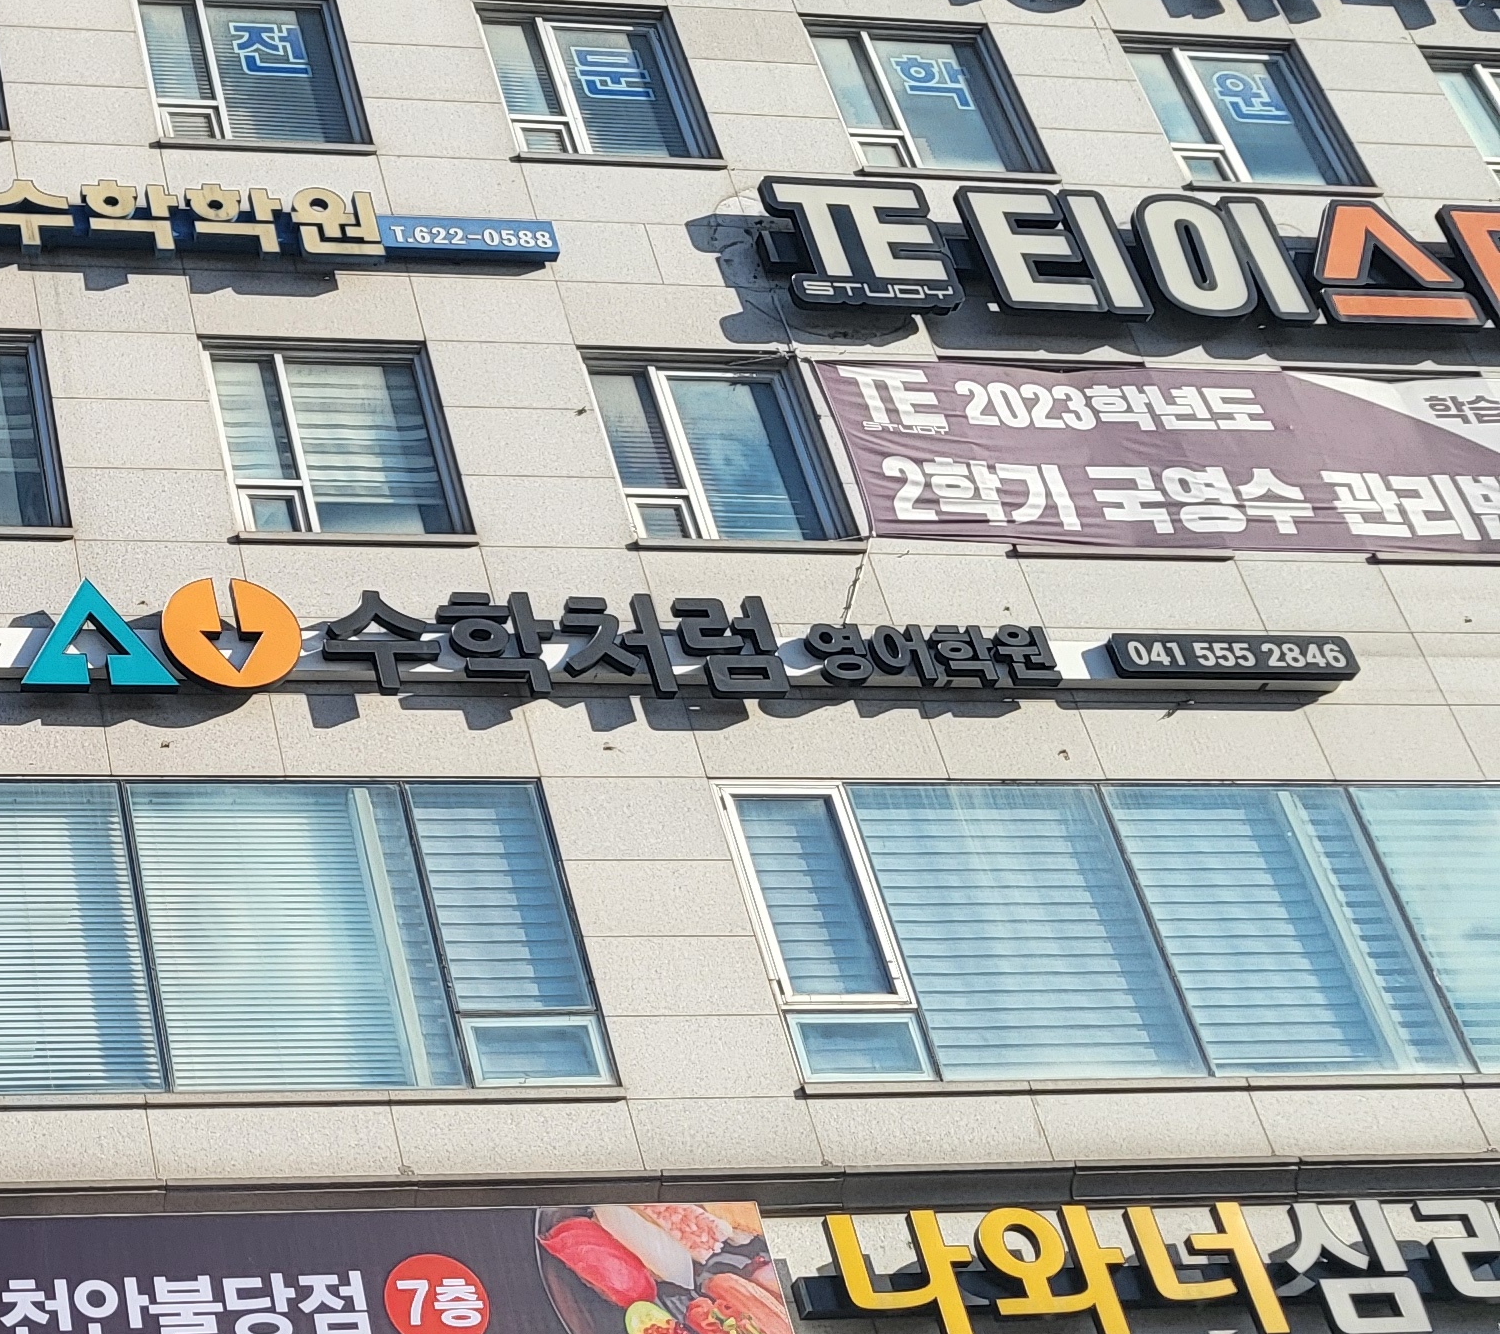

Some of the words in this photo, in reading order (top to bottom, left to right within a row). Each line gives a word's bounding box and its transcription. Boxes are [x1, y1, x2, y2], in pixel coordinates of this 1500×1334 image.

[389, 225, 554, 249] T.622-0588
[800, 279, 955, 302] STUDY
[861, 420, 952, 438] STUDY
[953, 378, 1278, 434] 2023학년도
[880, 454, 1085, 534] 2학기
[1084, 463, 1316, 537] 국영수
[320, 589, 792, 701] 수학처럼
[803, 620, 1065, 691] 영어학원
[1127, 638, 1188, 670] 041
[1193, 639, 1255, 670] 555
[1260, 640, 1348, 672] 2846
[395, 1277, 485, 1329] 7층
